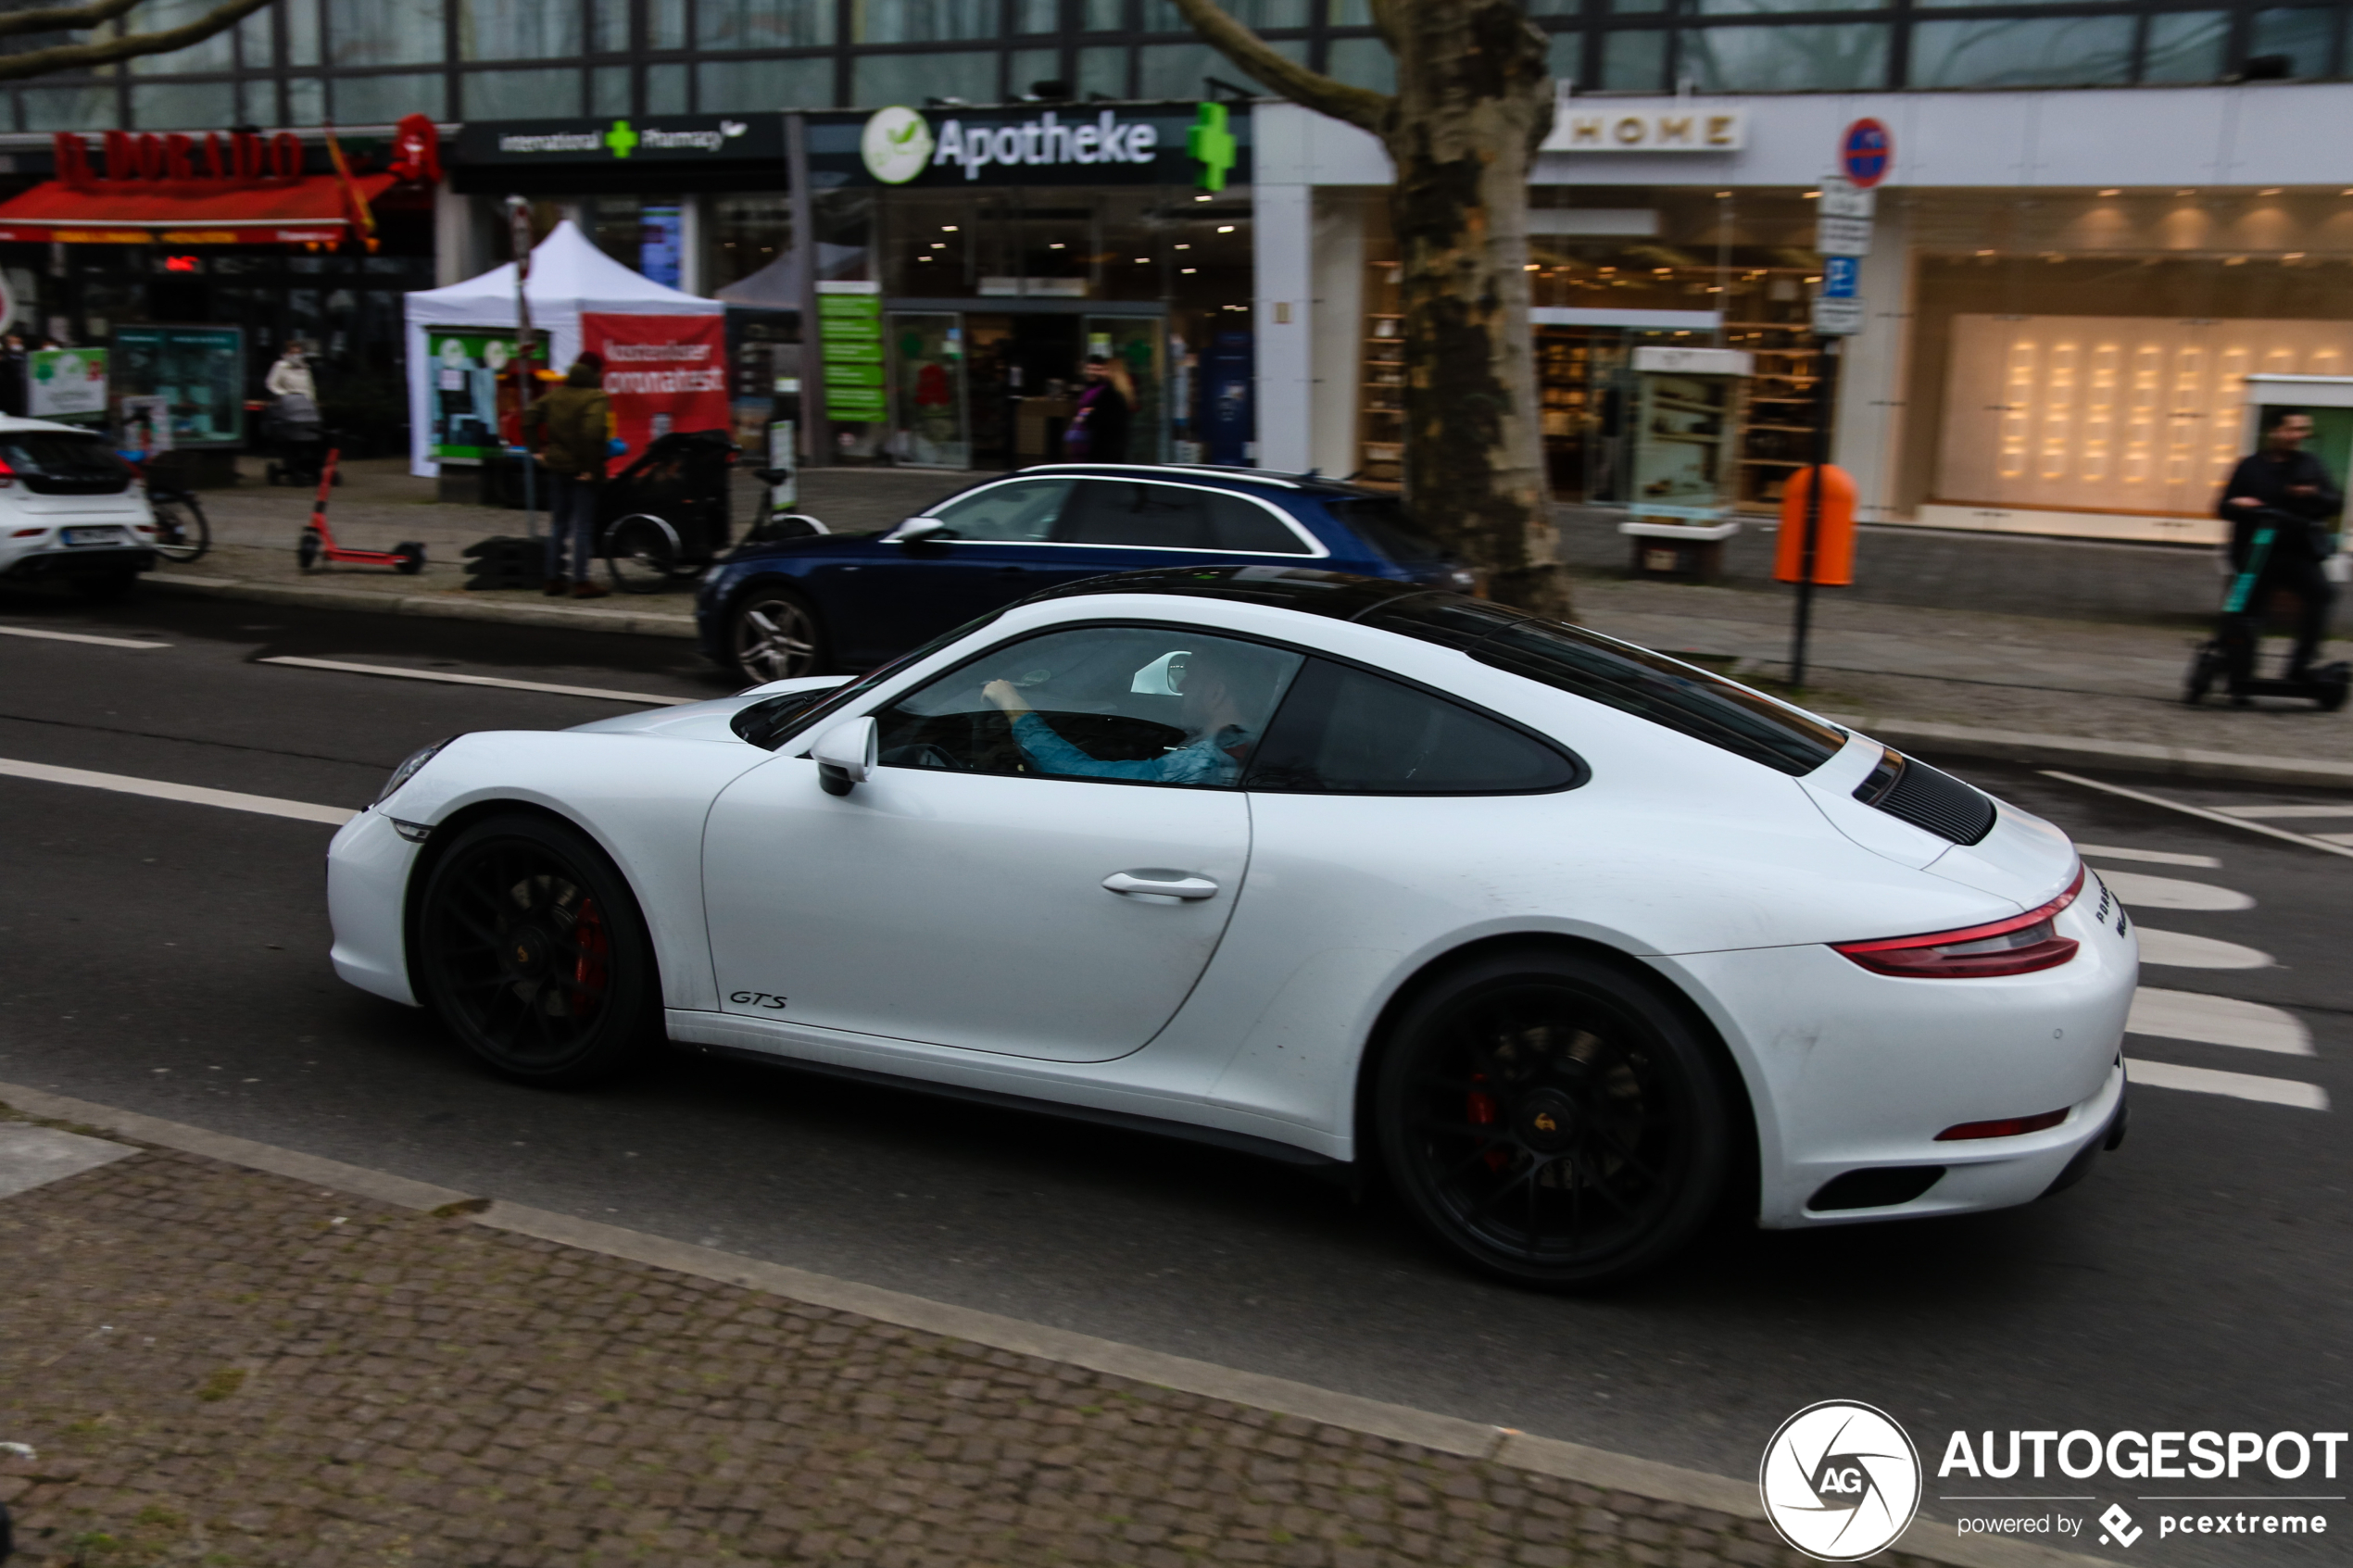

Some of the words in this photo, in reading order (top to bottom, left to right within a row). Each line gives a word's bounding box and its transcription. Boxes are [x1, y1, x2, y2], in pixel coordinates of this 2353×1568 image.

[498, 131, 602, 152] International
[641, 129, 723, 153] Pharmacy
[1572, 116, 1734, 145] HOME
[933, 110, 1157, 180] Apotheke
[730, 991, 787, 1009] GTS
